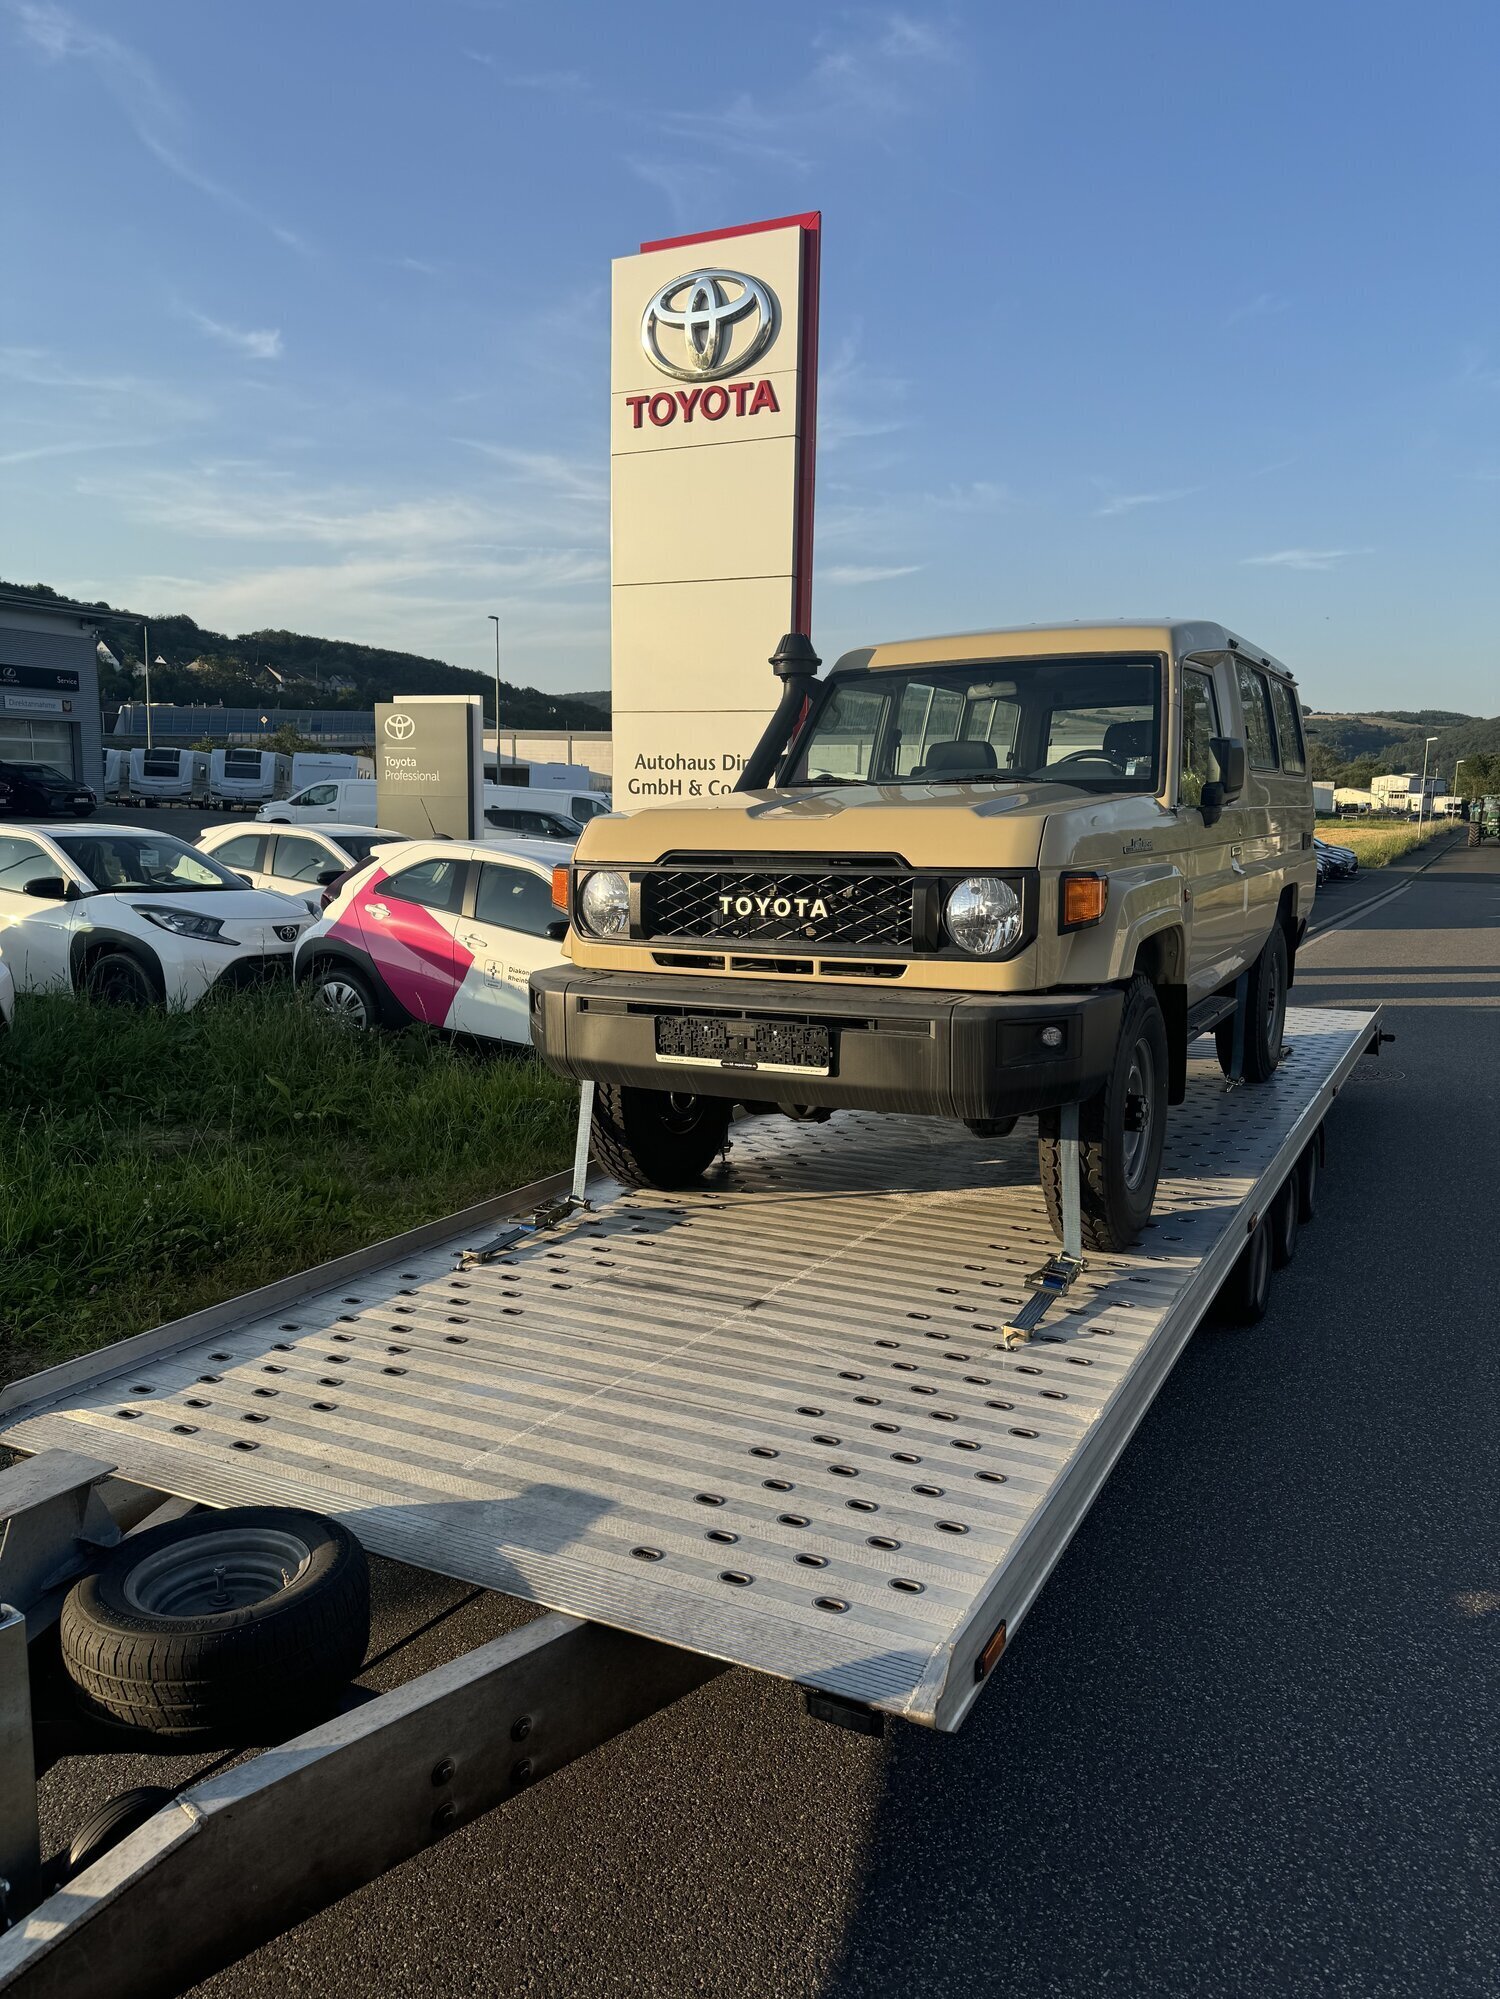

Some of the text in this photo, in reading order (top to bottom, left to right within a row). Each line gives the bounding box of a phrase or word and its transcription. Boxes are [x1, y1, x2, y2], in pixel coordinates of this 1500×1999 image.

[626, 380, 780, 428] TOYOTA
[56, 675, 77, 685] Service
[8, 698, 57, 709] Direktannahme
[384, 756, 417, 769] Toyota
[634, 753, 716, 771] Autohaus
[385, 770, 440, 782] Professional
[628, 779, 682, 796] GmbH
[688, 779, 702, 796] &
[719, 896, 828, 918] TOYOTA
